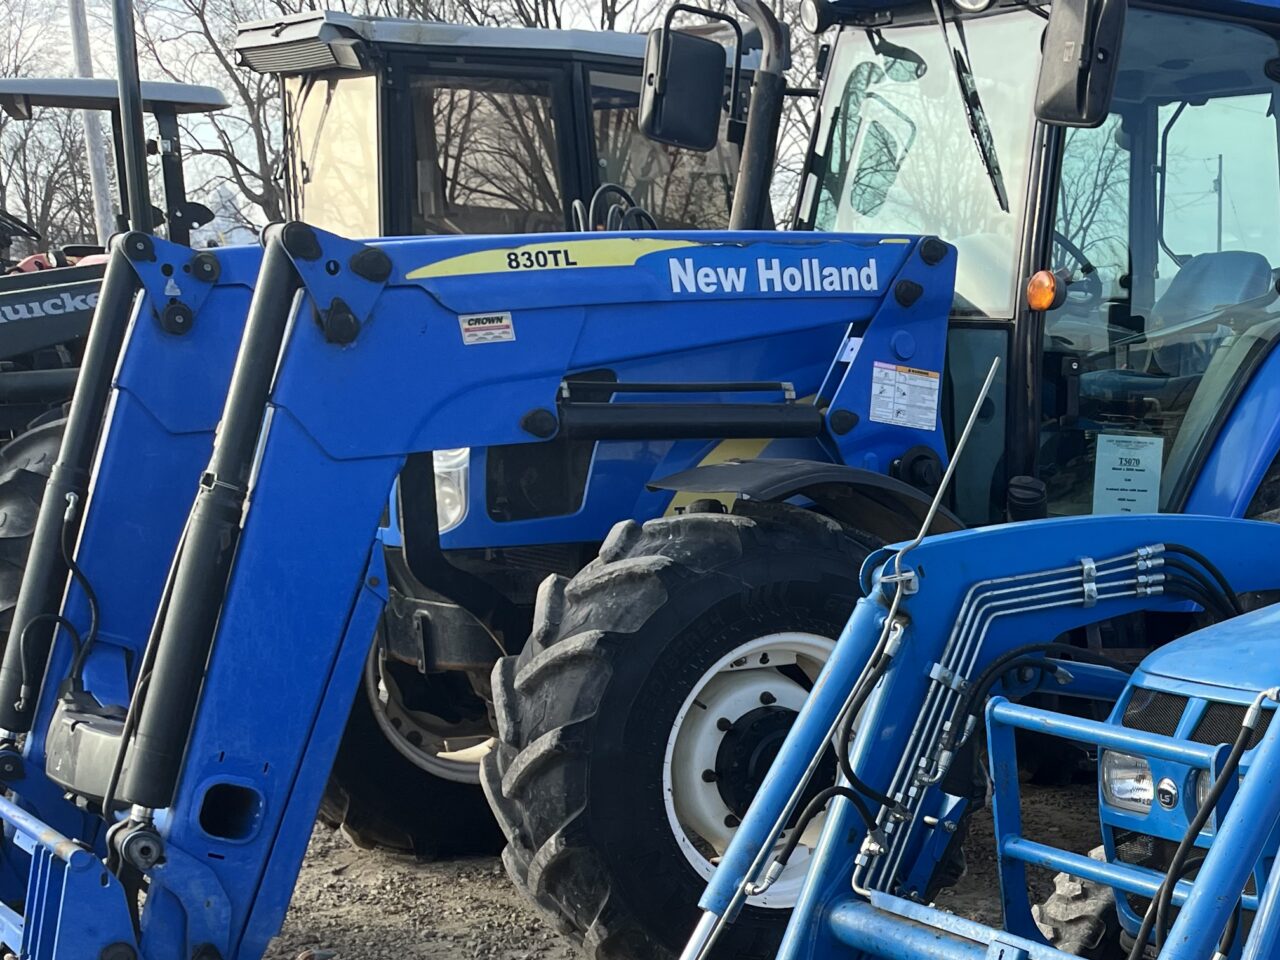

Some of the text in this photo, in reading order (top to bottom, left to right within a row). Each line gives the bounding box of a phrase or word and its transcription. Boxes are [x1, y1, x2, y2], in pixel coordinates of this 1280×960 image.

[507, 250, 578, 269] 830TL
[669, 258, 879, 293] New Holland
[467, 316, 503, 326] CROWN
